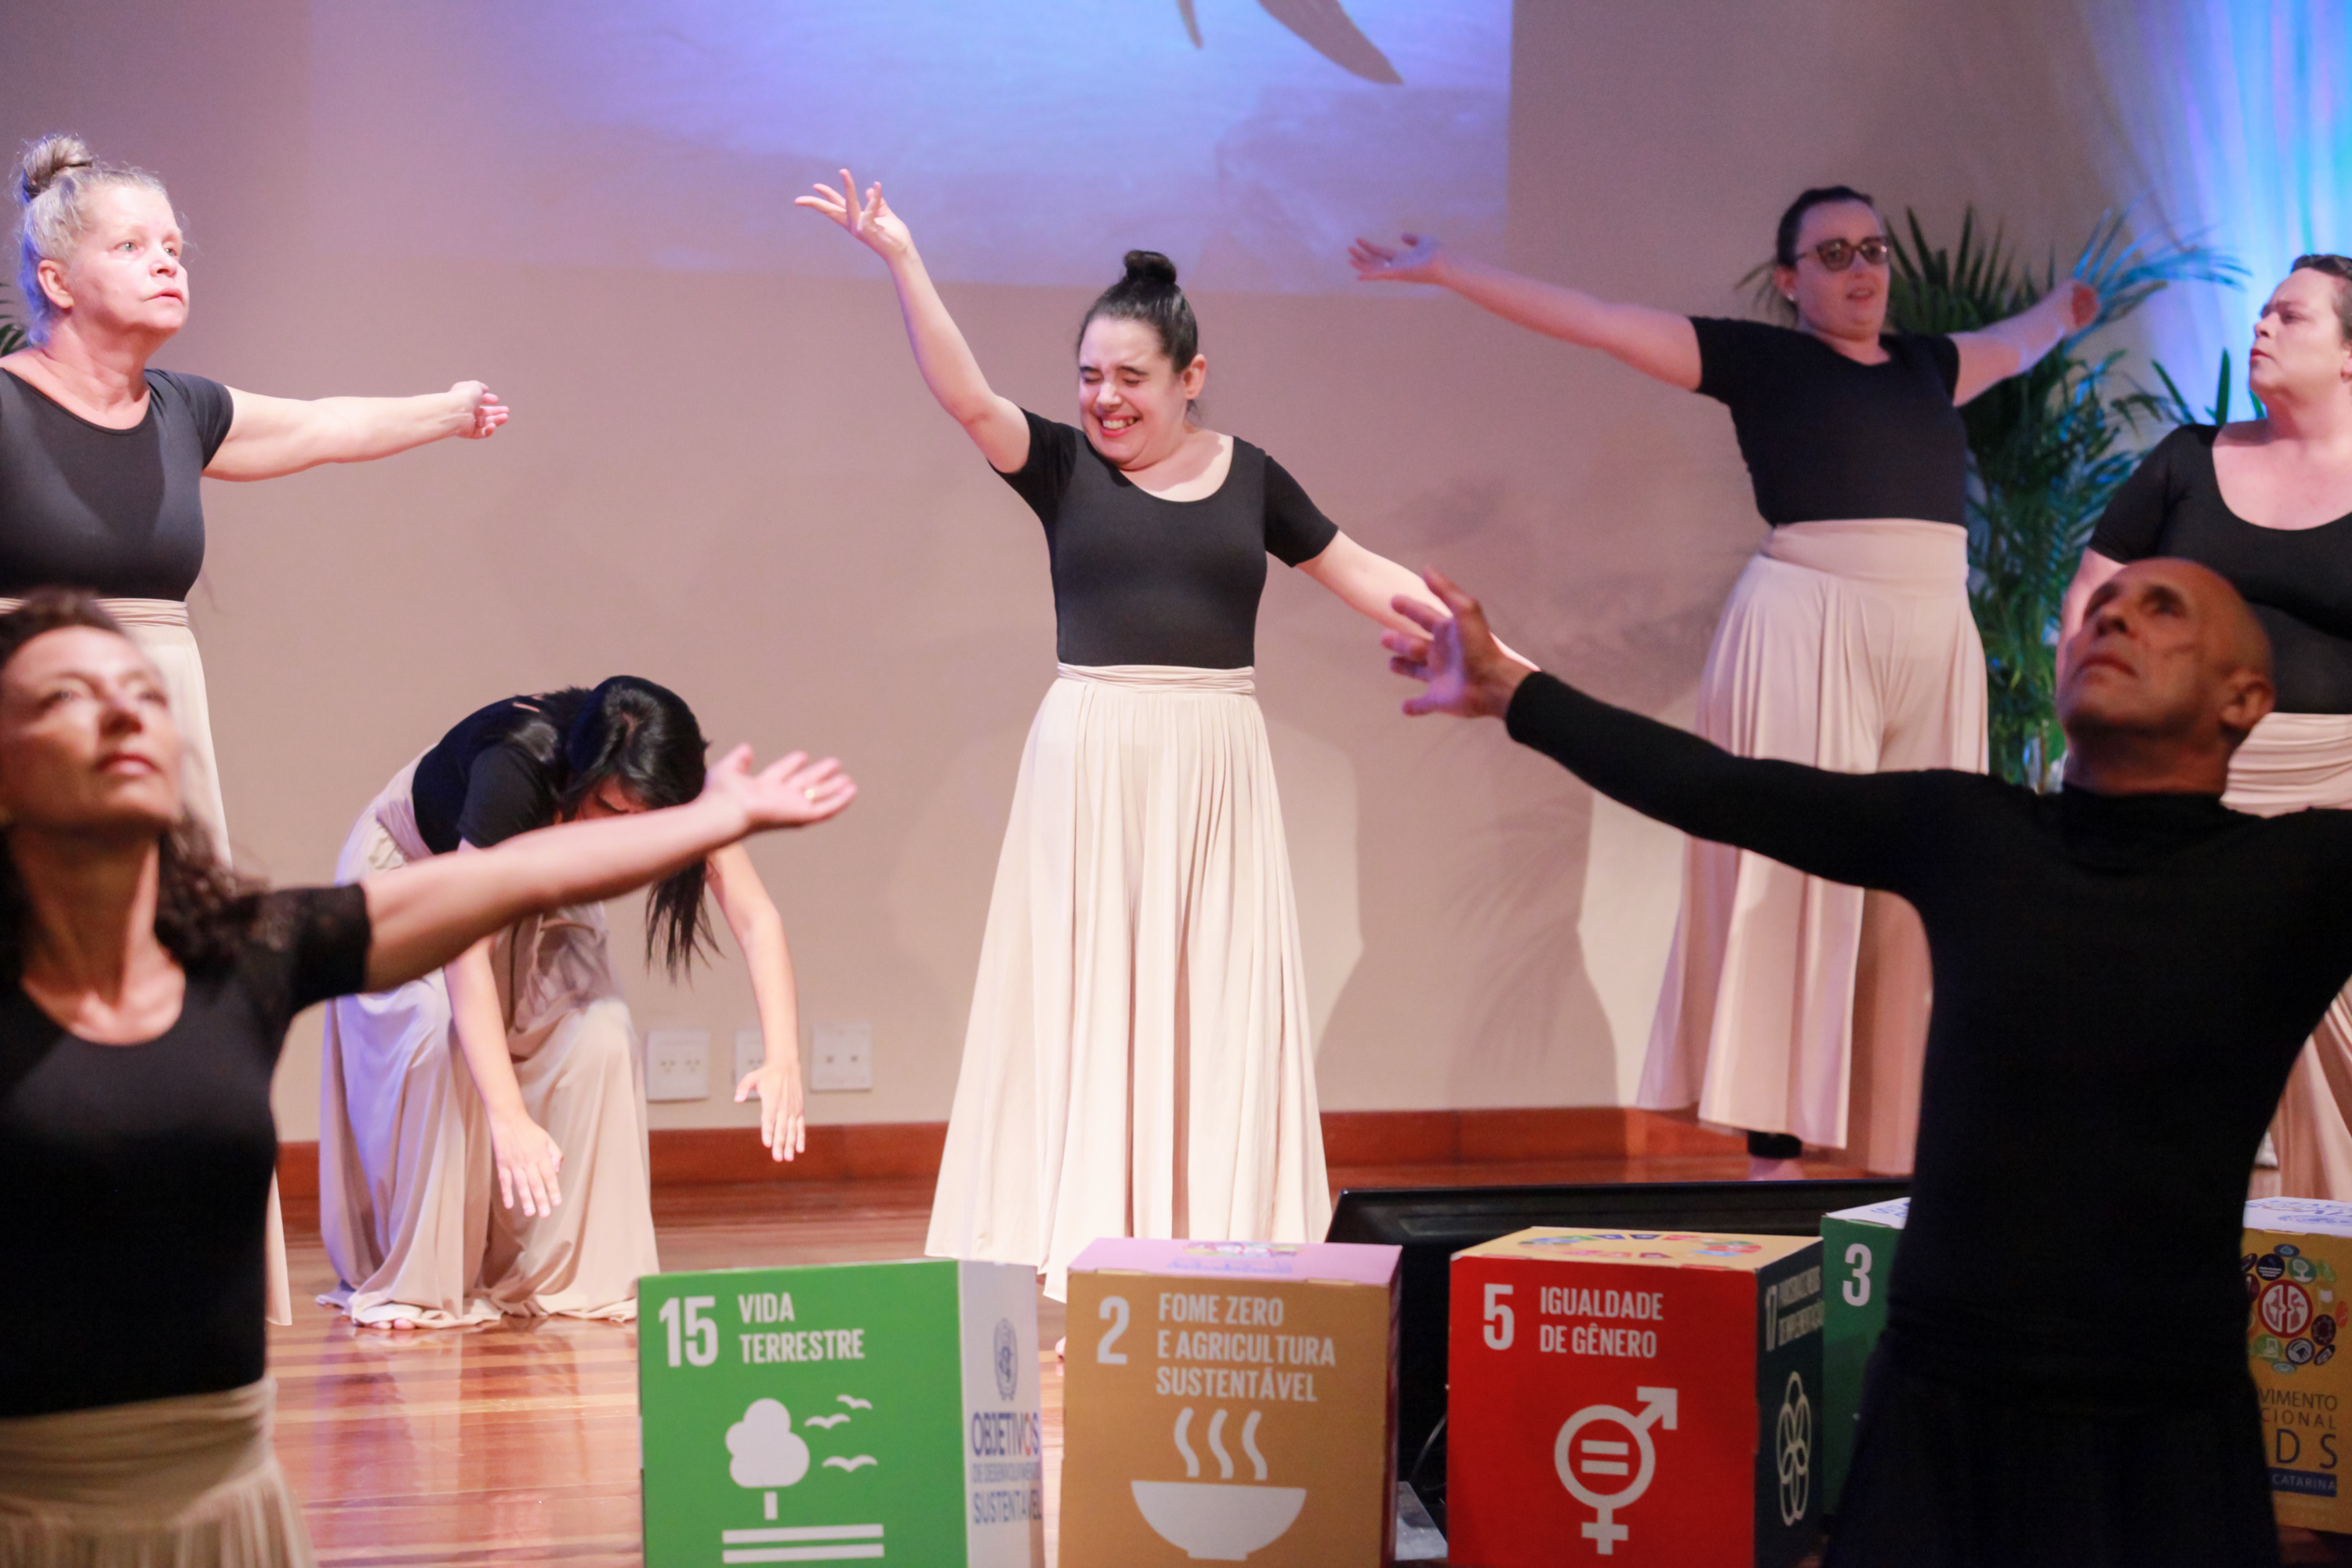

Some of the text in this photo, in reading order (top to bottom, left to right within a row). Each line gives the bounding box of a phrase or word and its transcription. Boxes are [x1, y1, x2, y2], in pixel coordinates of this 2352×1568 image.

[1842, 1243, 1872, 1306] 3
[738, 1292, 795, 1323] VIDA
[1159, 1293, 1283, 1326] FOME ZERO
[1483, 1283, 1515, 1350] 5
[1541, 1287, 1664, 1320] IGUALDADE
[659, 1296, 718, 1367] 15
[739, 1329, 865, 1363] TERRESTRE
[1098, 1296, 1131, 1364] 2
[1540, 1323, 1657, 1358] DE GÊNERO
[1157, 1330, 1336, 1366] E AGRICULTURA
[1156, 1367, 1318, 1402] SUSTENTÁVEL
[2259, 1387, 2338, 1411] VIMENTO
[2262, 1406, 2336, 1429] CIONAL
